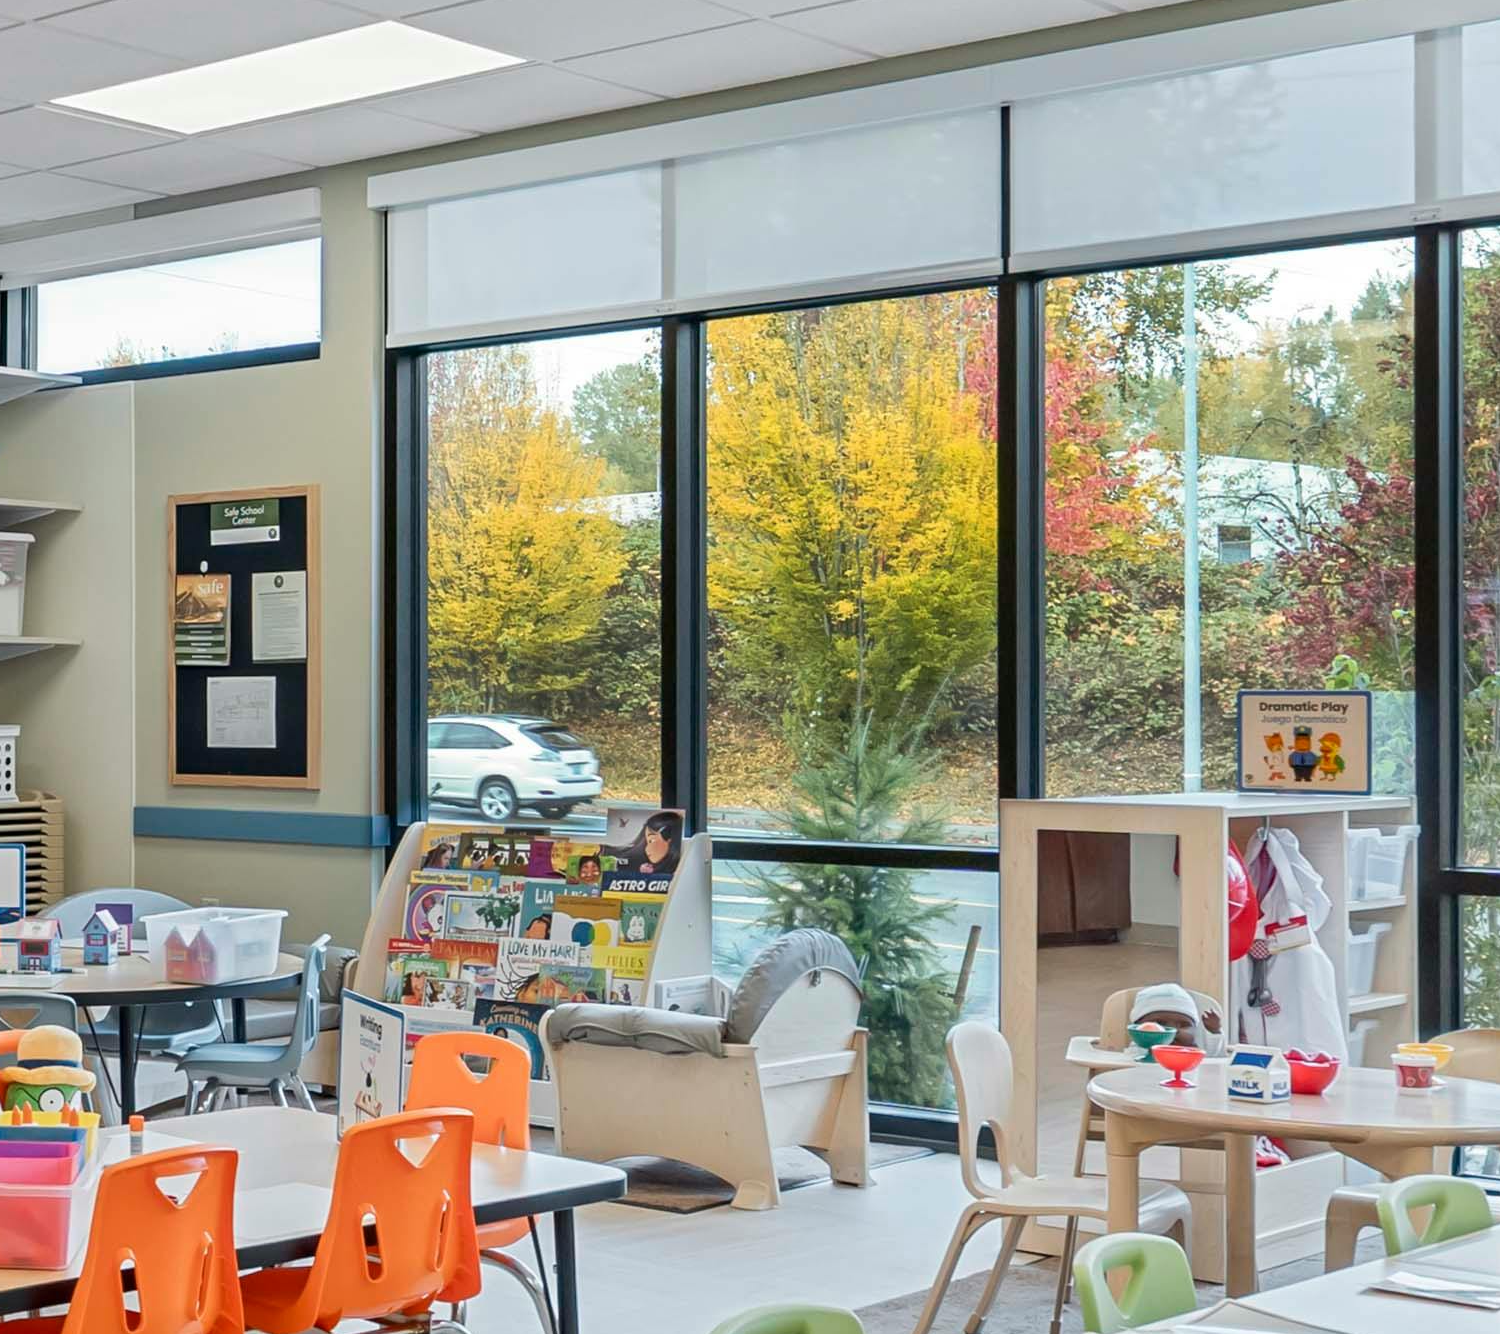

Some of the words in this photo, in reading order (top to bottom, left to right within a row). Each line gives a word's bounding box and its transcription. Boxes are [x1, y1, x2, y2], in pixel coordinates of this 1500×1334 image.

[224, 507, 239, 518] Safe
[240, 505, 265, 517] School
[231, 516, 256, 526] Center
[1259, 701, 1319, 712] Dramatic
[1321, 701, 1349, 715] Play
[1261, 715, 1292, 725] Juego
[609, 880, 646, 892] ASTRO
[508, 943, 529, 955] LOVE
[550, 945, 577, 959] HAIR!
[360, 1013, 383, 1041] Writing
[480, 1014, 539, 1033] KATHERINE
[1232, 1079, 1260, 1090] MILK
